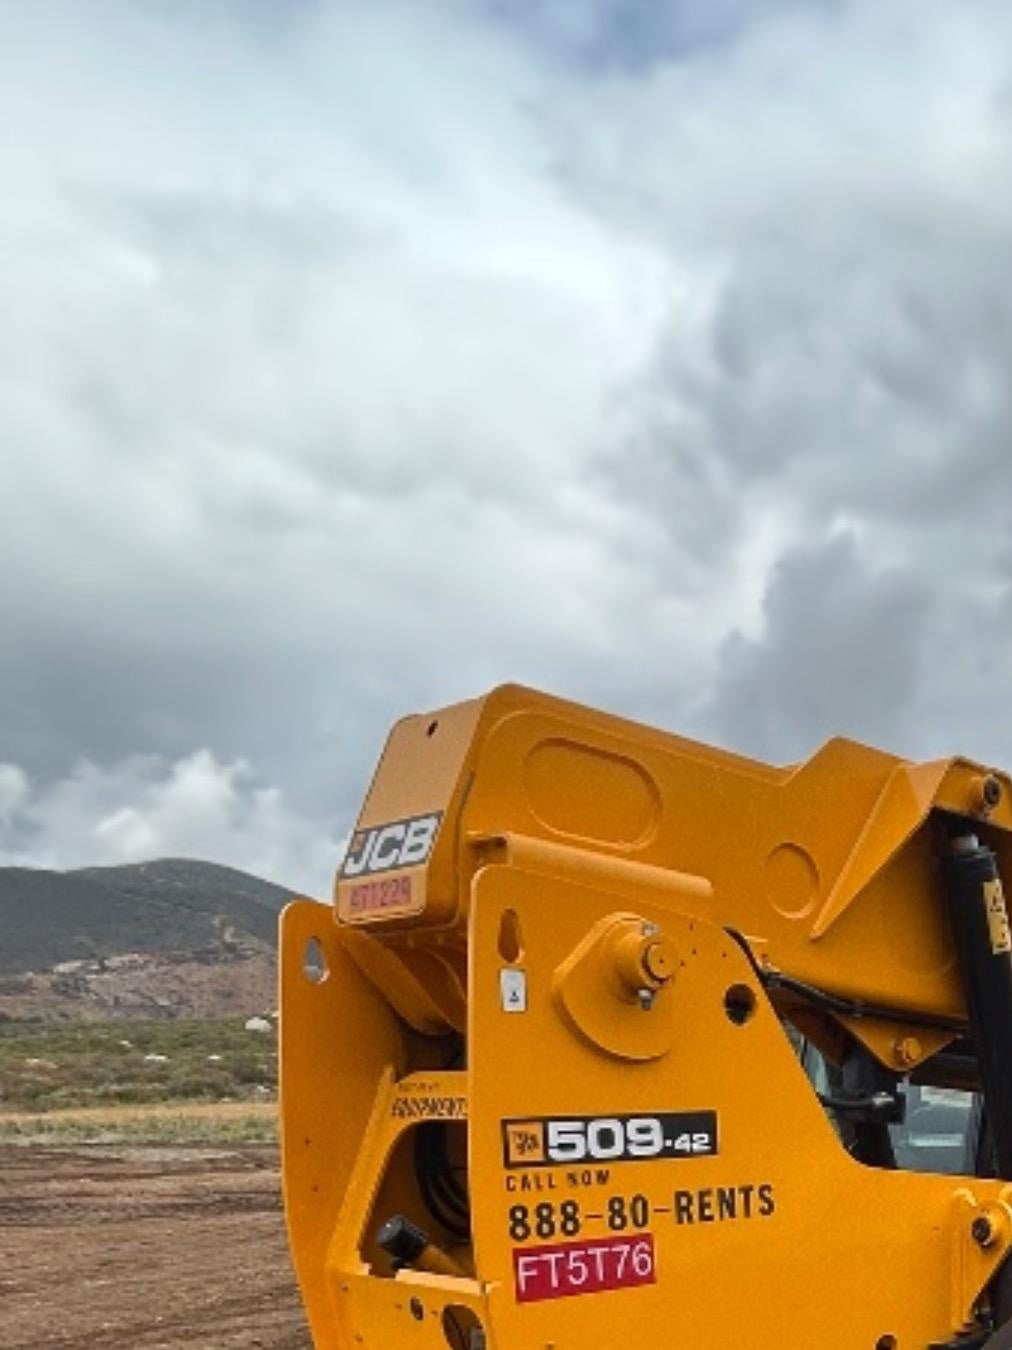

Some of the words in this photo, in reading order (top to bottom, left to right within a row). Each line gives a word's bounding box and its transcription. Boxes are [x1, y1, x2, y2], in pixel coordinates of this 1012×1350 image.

[343, 815, 441, 875] JCB
[391, 1097, 468, 1117] EQUIPMENT
[505, 1174, 557, 1193] CALL
[567, 1169, 611, 1188] NOW
[508, 1184, 775, 1242] 888-80-RENTS
[517, 1241, 652, 1294] FT5T76
